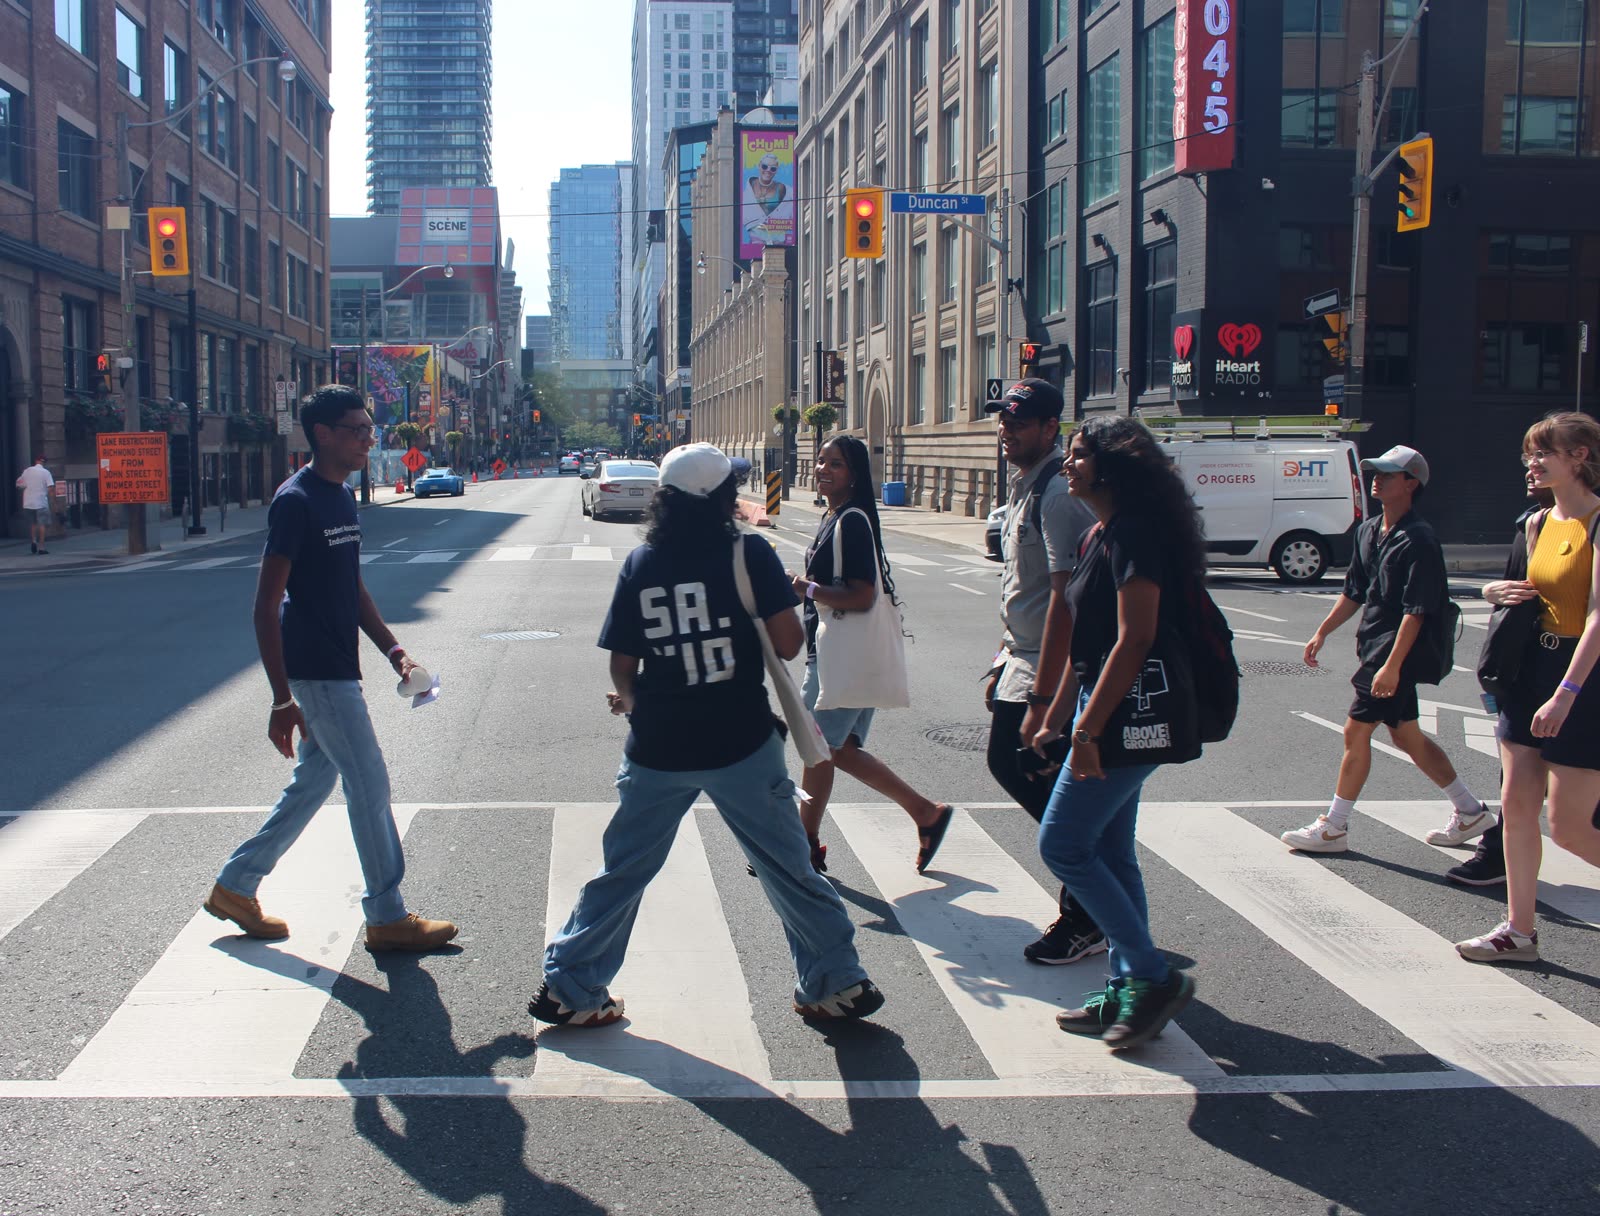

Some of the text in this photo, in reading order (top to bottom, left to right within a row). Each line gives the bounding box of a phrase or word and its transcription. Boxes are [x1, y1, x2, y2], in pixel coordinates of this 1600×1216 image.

[908, 195, 968, 209] Duncan St
[1215, 359, 1260, 373] iHeart
[1172, 373, 1191, 386] RADIO
[1215, 373, 1260, 385] RADIO
[101, 437, 163, 446] LANE RESTRICTIONS
[103, 448, 161, 457] RICHMOND STREET
[121, 459, 144, 467] FROM
[104, 470, 162, 478] JOHN STREET TO
[1283, 461, 1329, 477] DHT
[1211, 474, 1256, 484] ROGERS
[106, 481, 161, 489] WIDMER STREET
[323, 527, 343, 537] Student
[1122, 723, 1166, 740] ABOVE
[1123, 738, 1167, 750] GROUND
